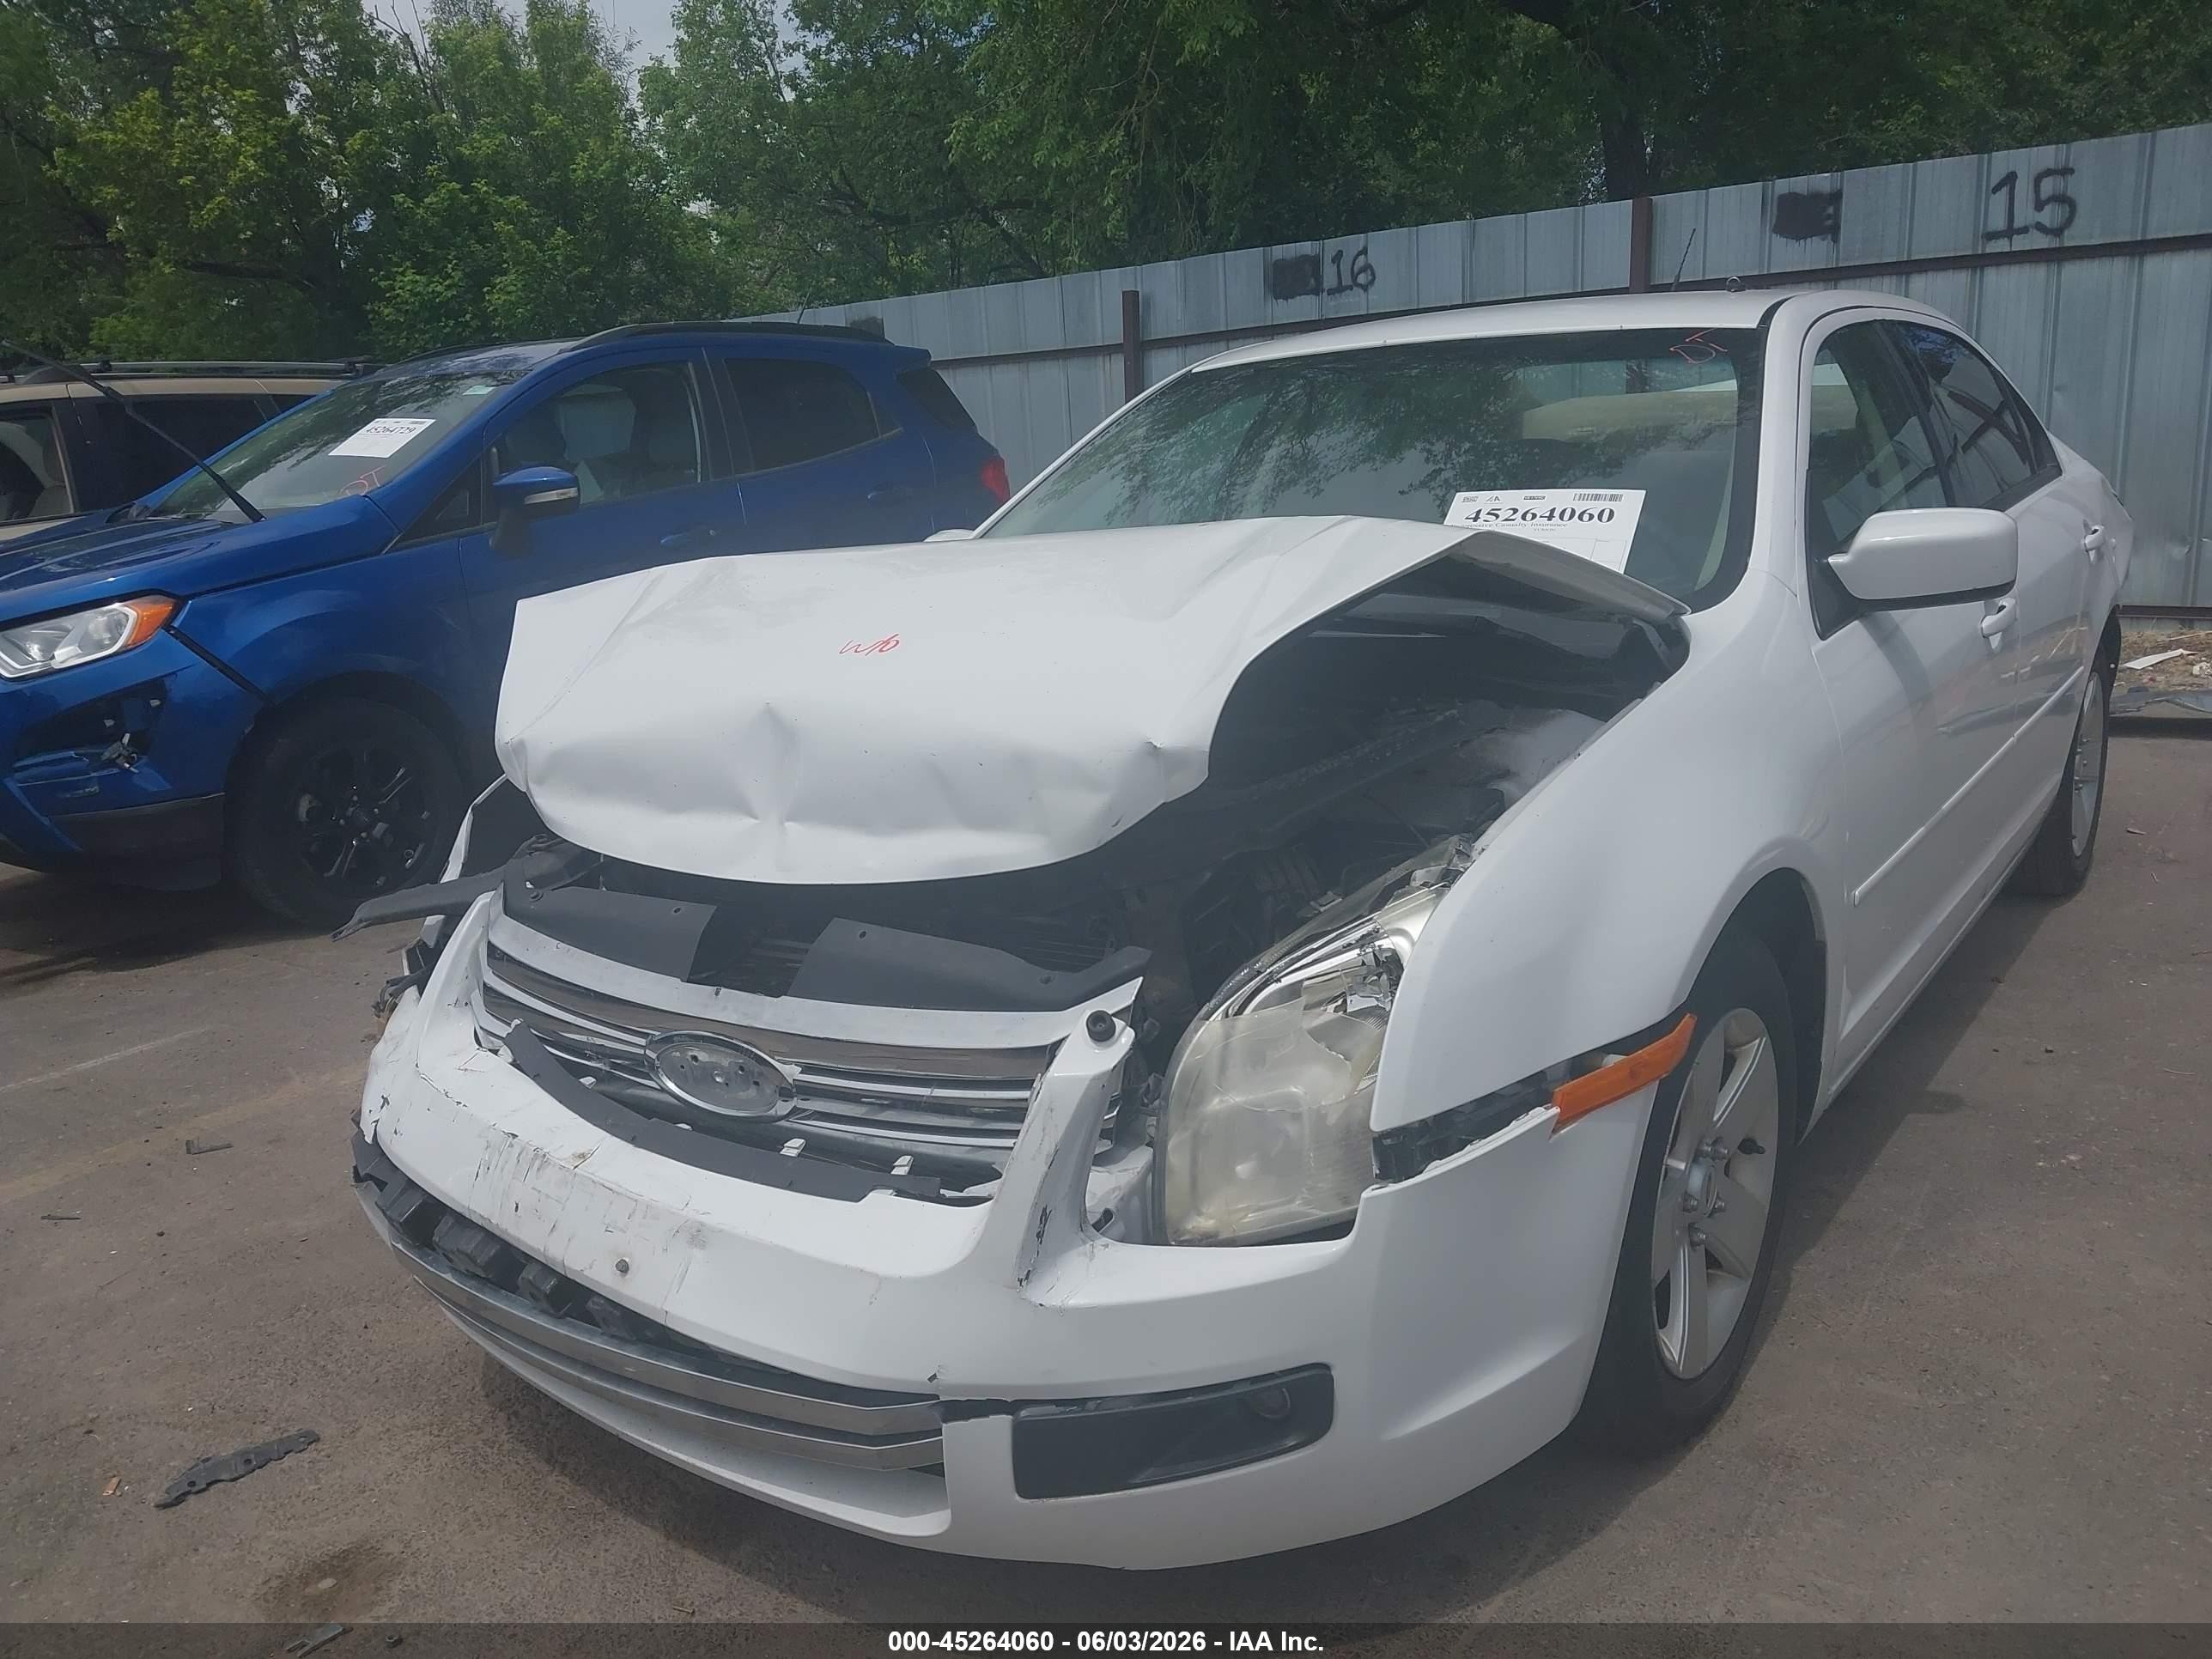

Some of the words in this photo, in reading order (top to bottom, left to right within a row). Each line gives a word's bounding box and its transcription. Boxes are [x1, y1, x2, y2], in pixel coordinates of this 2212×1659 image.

[1982, 167, 2077, 241] 15
[1327, 246, 1376, 294] 16
[1464, 507, 1615, 523] 45264060
